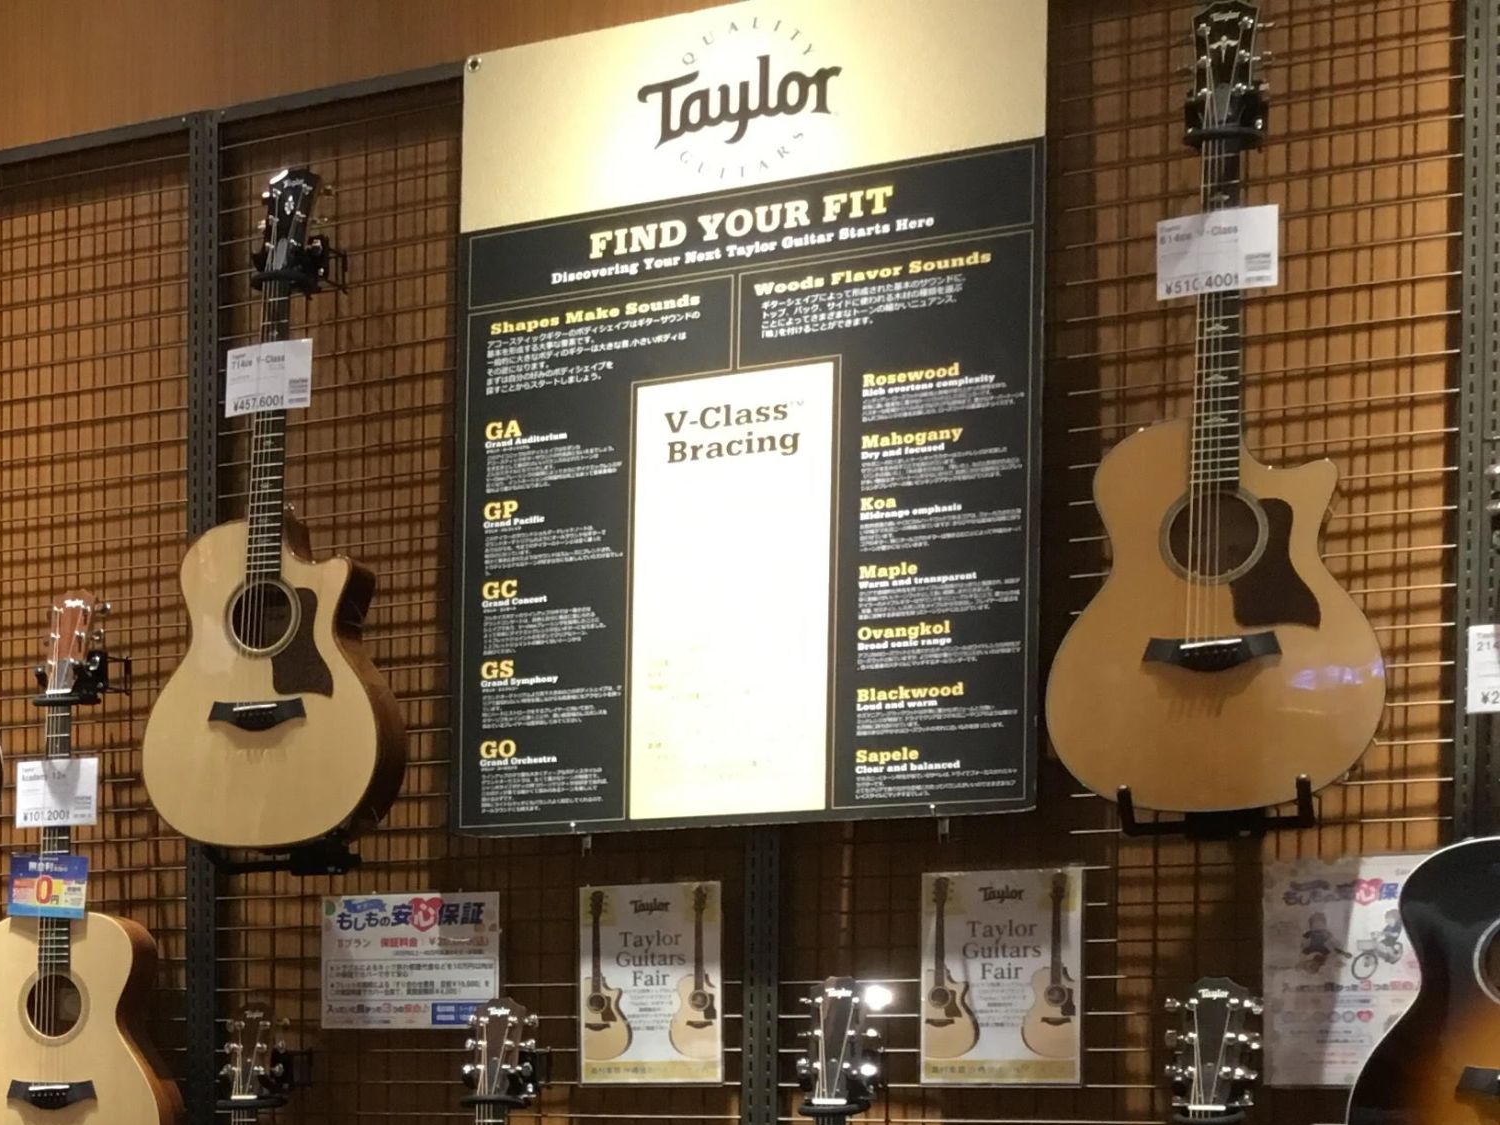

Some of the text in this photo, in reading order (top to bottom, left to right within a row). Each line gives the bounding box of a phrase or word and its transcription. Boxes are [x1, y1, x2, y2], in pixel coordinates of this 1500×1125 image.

[682, 17, 816, 66] QUALITY
[637, 55, 843, 150] Taylor
[589, 185, 894, 260] FIND YOUR FIT
[551, 215, 935, 285] Discovering Your Next Taylor Guitar Starts Here
[754, 251, 992, 297] Woods Flavor Sounds
[490, 294, 701, 336] Shapes Make Sounds
[862, 362, 960, 388] Rosewood
[862, 373, 996, 398] Rich overtone complexity
[484, 432, 568, 449] Grand Auditorium
[485, 420, 522, 441] GA
[861, 427, 964, 450] Mahogany
[667, 431, 801, 464] Bracing
[861, 442, 946, 461] Dry and focused
[483, 500, 519, 521] GP
[860, 496, 897, 511] Koa
[860, 502, 963, 521] Midrange emphasis
[483, 514, 546, 530] Grand Pacific
[858, 562, 918, 582] Maple
[858, 571, 977, 590] Warm and transparent
[482, 579, 518, 600] GC
[481, 595, 548, 609] Grand Concert
[857, 620, 952, 642] Ovangkol
[857, 641, 889, 651] Broad
[920, 636, 952, 647] range
[481, 660, 515, 680] GS
[480, 674, 559, 688] Grand Symphony
[856, 682, 964, 703] Blackwood
[856, 699, 938, 711] Loud and warm
[480, 739, 517, 759] GO
[855, 746, 920, 765] Sapele
[479, 754, 558, 768] Grand Orchestra
[855, 760, 961, 774] Clear and balanced
[979, 886, 1025, 904] Taylor
[336, 898, 486, 932] もしもの安心保証
[629, 899, 672, 915] Taylor
[618, 929, 682, 951] Taylor
[967, 919, 1038, 942] Taylor
[616, 949, 687, 968] Guitars
[962, 942, 1042, 960] Guitars
[632, 970, 671, 987] Fair
[980, 962, 1024, 981] Fair
[1198, 987, 1229, 999] Taylor
